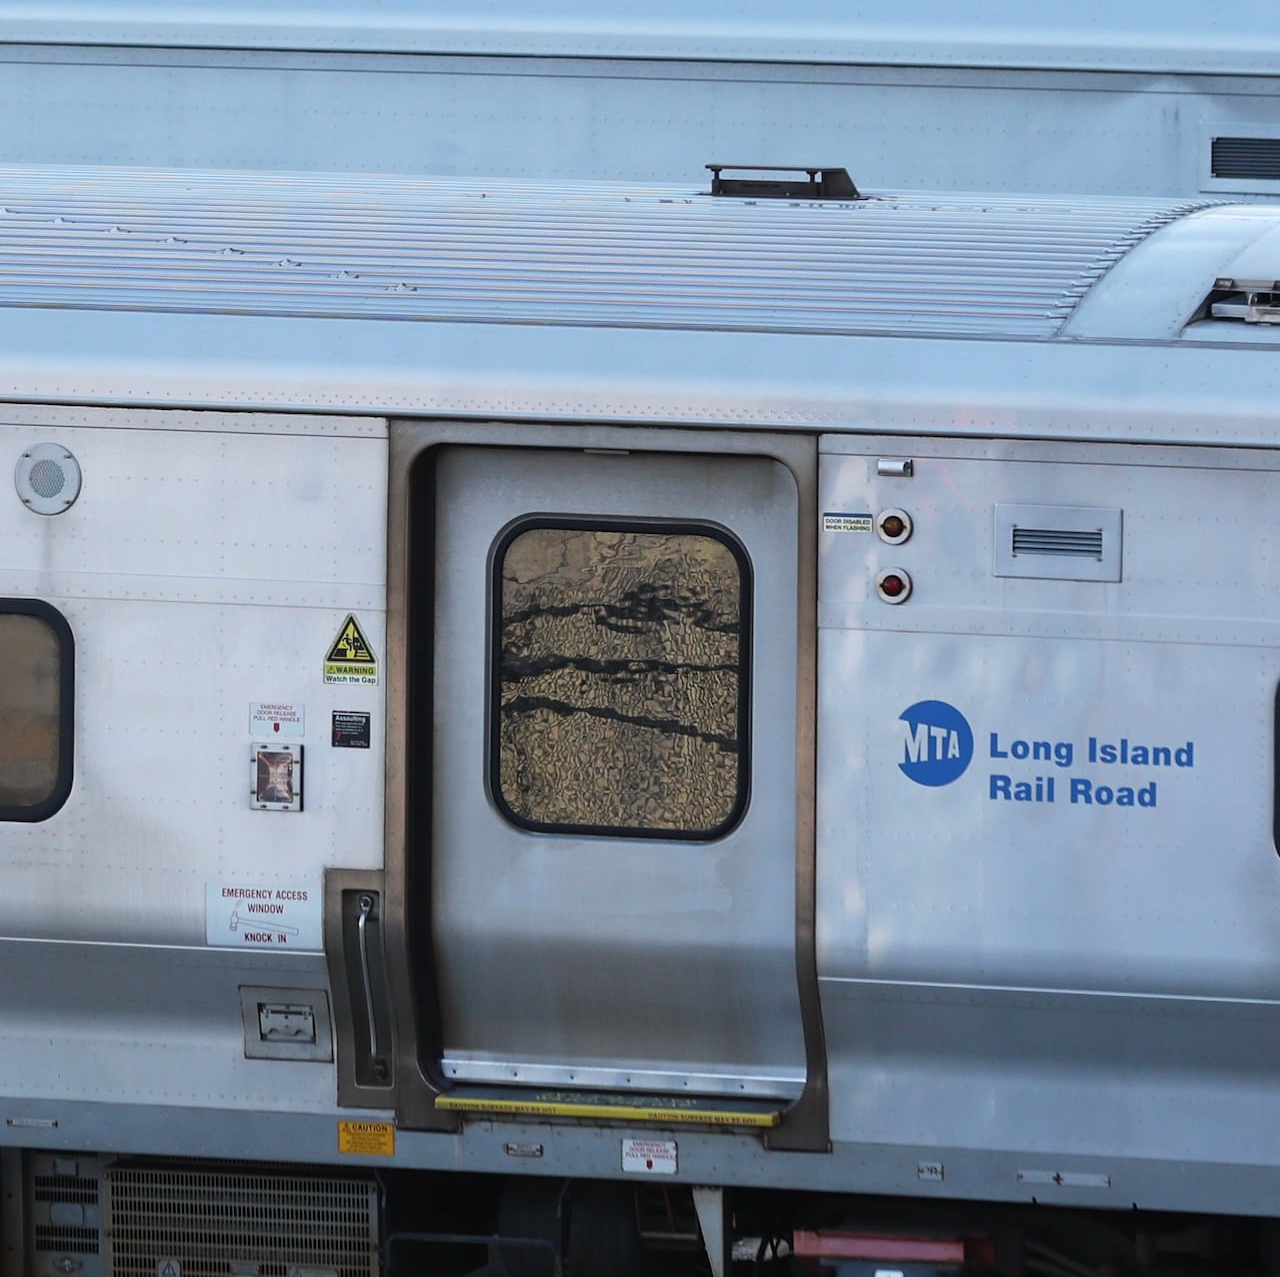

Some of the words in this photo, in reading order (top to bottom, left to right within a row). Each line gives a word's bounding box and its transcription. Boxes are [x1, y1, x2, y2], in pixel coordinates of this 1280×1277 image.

[336, 666, 374, 674] WARNING
[325, 675, 347, 683] Watch
[361, 676, 376, 684] Gap
[990, 732, 1074, 767] Long
[1088, 737, 1194, 768] Island
[989, 774, 1055, 803] Rail
[1070, 777, 1157, 807] Road
[222, 887, 273, 899] EMERGENCY
[275, 890, 308, 901] ACCESS
[247, 903, 284, 914] WINDOW
[244, 932, 273, 943] KNOCK
[277, 933, 287, 943] IN
[352, 1123, 388, 1132] CAUTION
